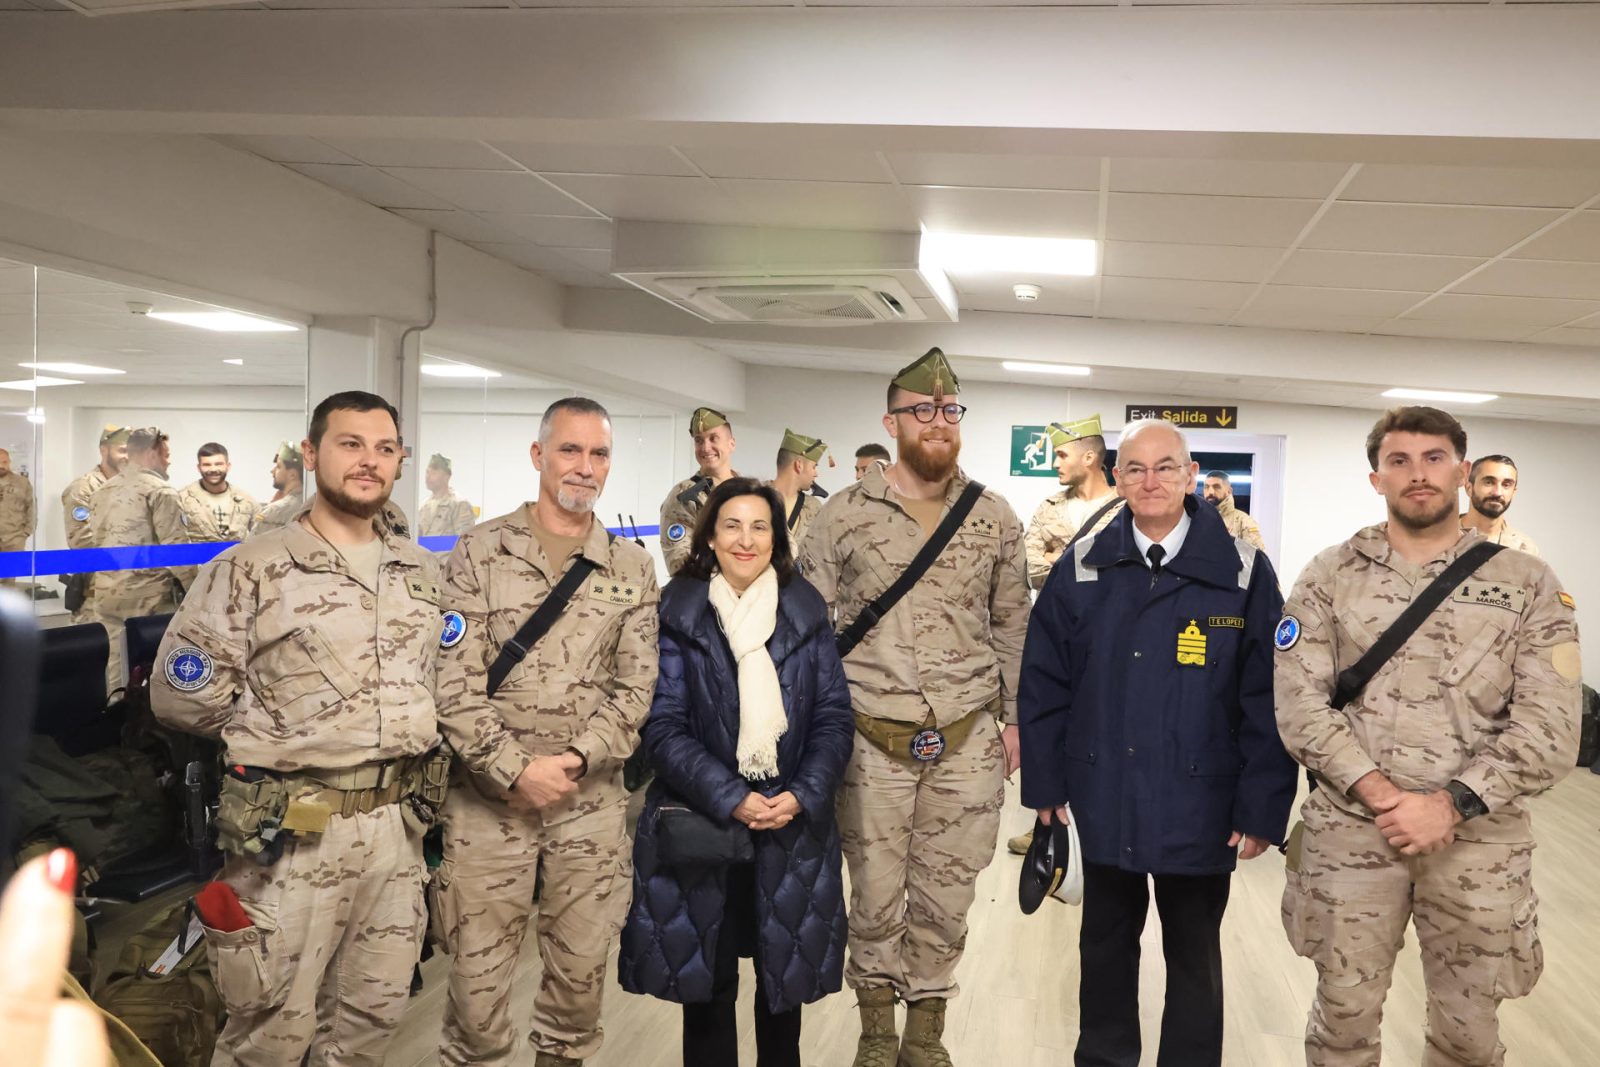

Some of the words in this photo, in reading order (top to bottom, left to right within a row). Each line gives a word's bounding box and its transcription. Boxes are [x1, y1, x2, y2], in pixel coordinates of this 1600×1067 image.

[1130, 409, 1156, 420] Exit
[1162, 410, 1208, 423] Salida
[1475, 596, 1513, 608] MARCOS
[1222, 618, 1241, 626] LOPEZ
